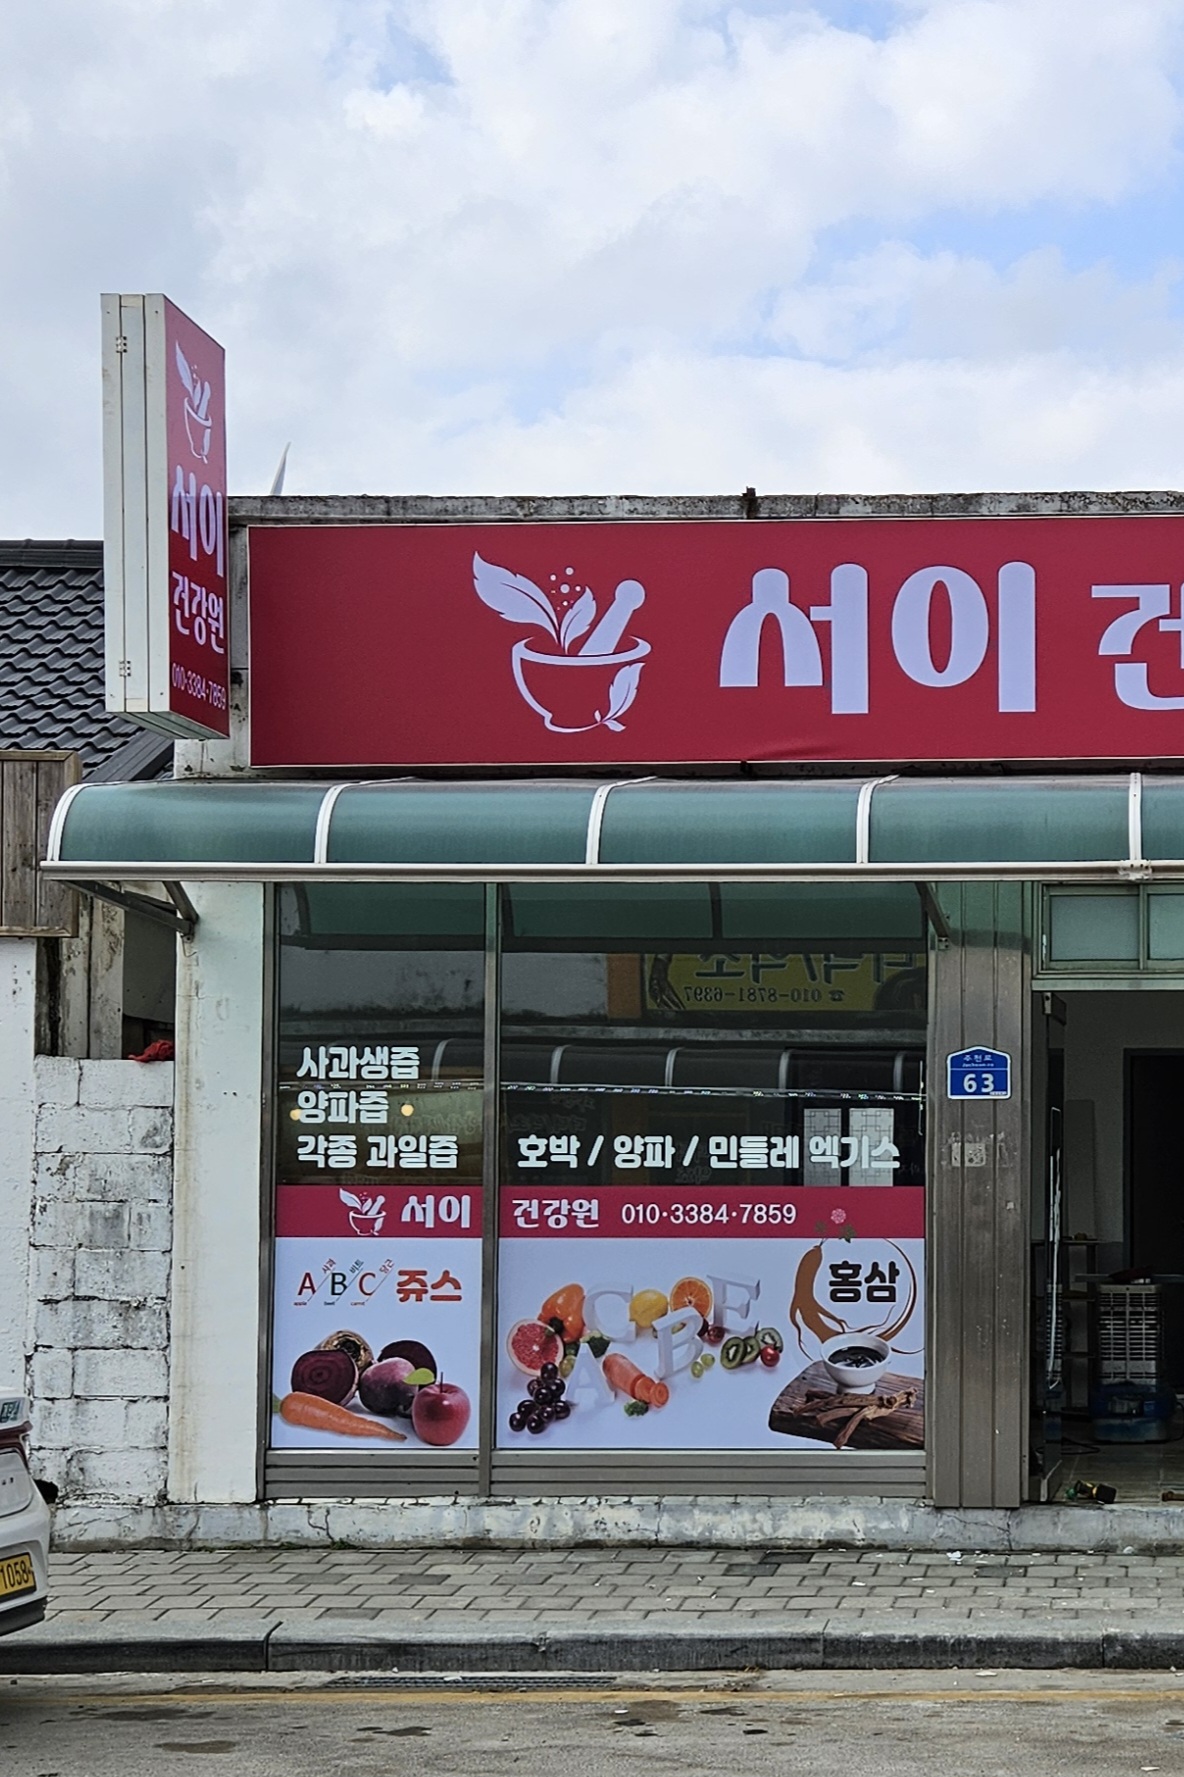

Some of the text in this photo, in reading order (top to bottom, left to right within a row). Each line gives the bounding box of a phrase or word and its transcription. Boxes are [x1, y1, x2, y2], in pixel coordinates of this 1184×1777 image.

[171, 464, 224, 578] 서이
[171, 571, 225, 654] 건강원
[719, 561, 1037, 715] 서이
[296, 1046, 420, 1080] 사과생즙
[963, 1073, 995, 1093] 63
[297, 1090, 389, 1124] 양파즙
[297, 1134, 459, 1169] 각종 과일즙
[517, 1134, 580, 1168] 호박
[613, 1135, 676, 1168] 양파
[708, 1134, 800, 1169] 민들레
[808, 1134, 901, 1169] 엑기스
[401, 1194, 471, 1229] 서이
[512, 1198, 600, 1230] 건강원
[297, 1269, 463, 1303] A B C 쥬스
[828, 1260, 900, 1304] 홍삼
